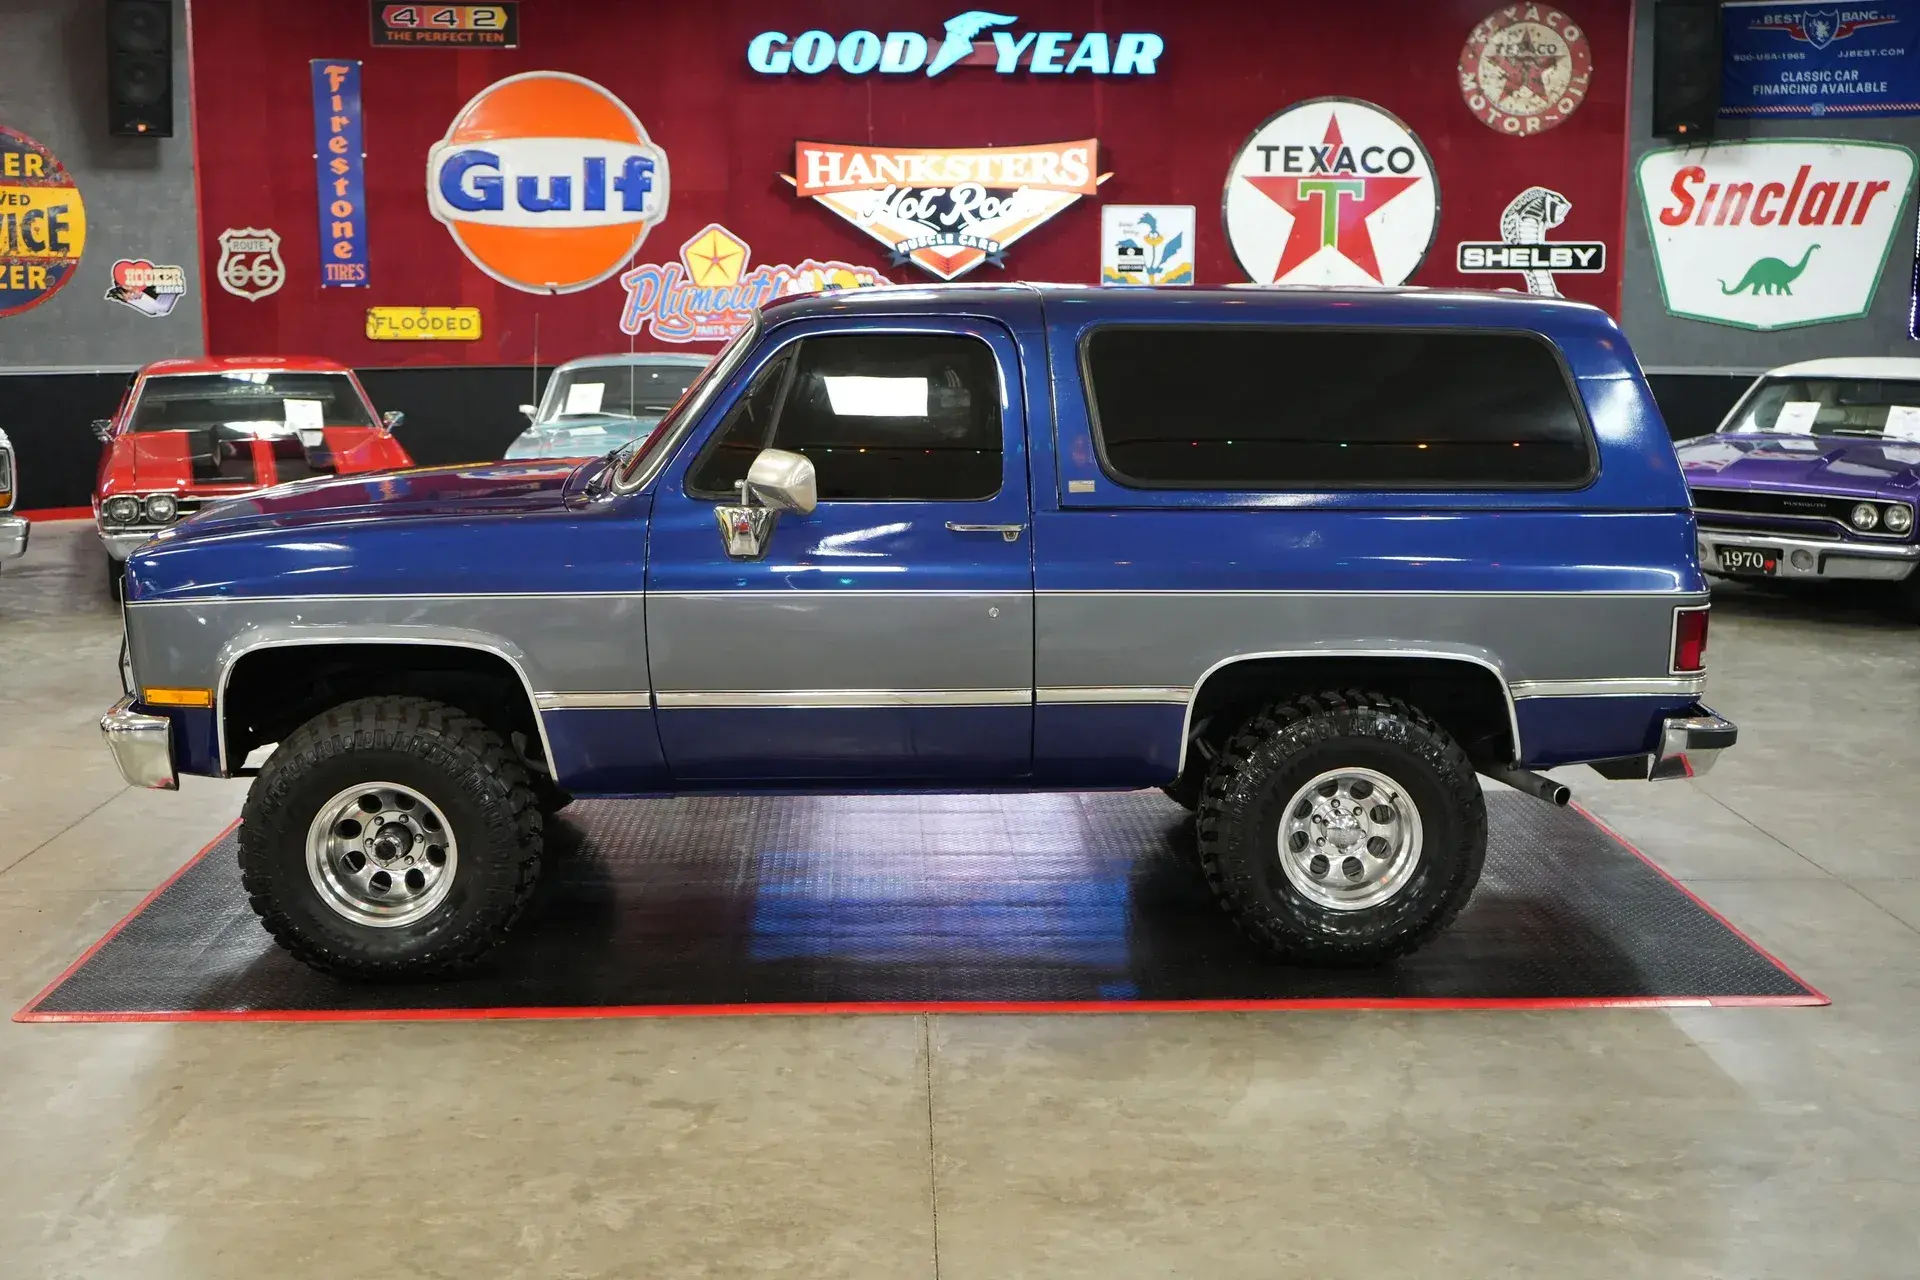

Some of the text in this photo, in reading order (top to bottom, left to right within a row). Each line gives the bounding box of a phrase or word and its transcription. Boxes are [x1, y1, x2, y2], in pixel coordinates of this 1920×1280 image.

[1763, 13, 1802, 25] BEST
[386, 31, 505, 43] THE PERFECT TEN
[1780, 69, 1860, 83] CLASSIC CAR
[1752, 82, 1888, 96] FINANCING AVAILABLE
[323, 65, 354, 259] Firestone
[803, 148, 1091, 190] HANKSTERS
[1256, 144, 1415, 174] TEXACO
[439, 149, 655, 212] Gulf
[856, 181, 1048, 228] Hot Rod
[1659, 164, 1891, 227] Sinclair
[232, 240, 266, 251] ROUTE
[898, 233, 999, 253] MUSCLE CARS
[1463, 247, 1598, 268] SHELBY
[228, 253, 274, 287] 66
[325, 263, 365, 281] TIRES
[375, 316, 472, 331] FLOODED
[1723, 550, 1764, 568] 1970
